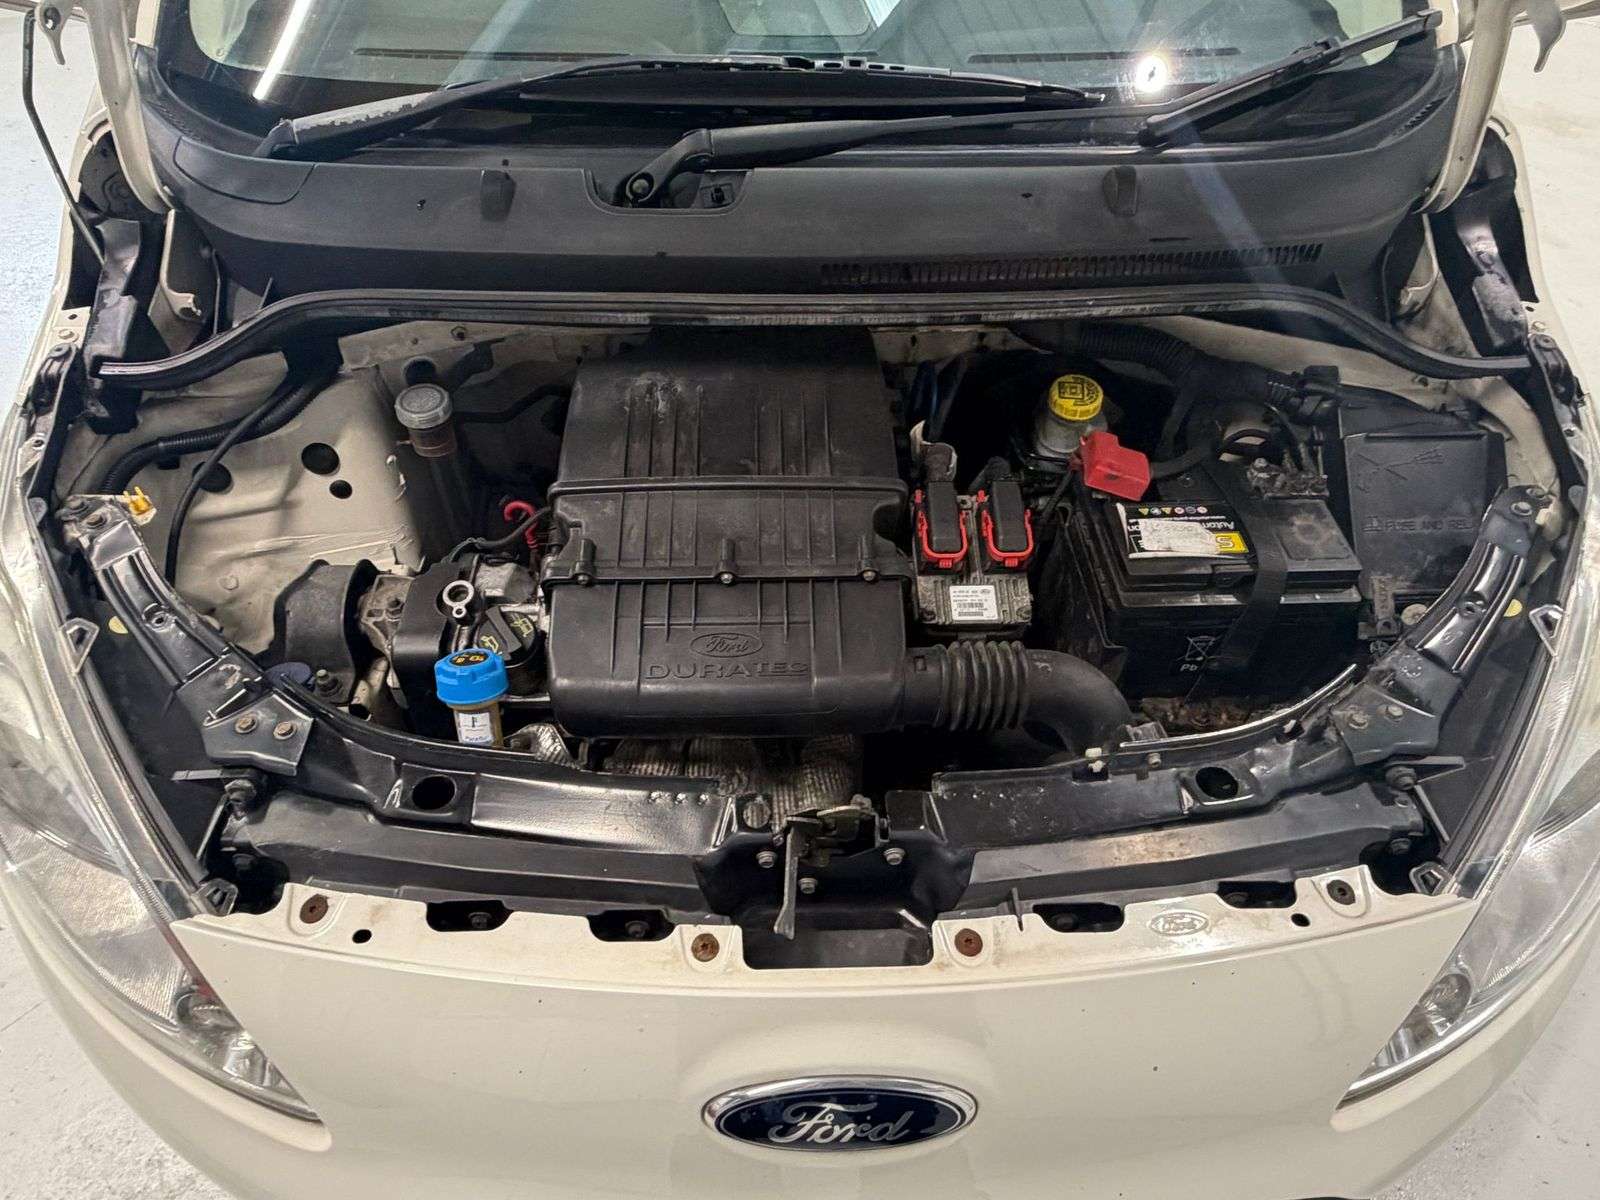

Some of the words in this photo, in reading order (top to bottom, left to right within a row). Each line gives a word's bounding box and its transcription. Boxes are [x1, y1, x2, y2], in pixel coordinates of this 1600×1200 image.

[1200, 520, 1235, 530] Autom
[1421, 519, 1444, 531] AND
[1448, 518, 1474, 530] REL
[705, 635, 750, 653] Ford
[1180, 663, 1199, 672] Pb
[768, 1101, 910, 1144] Ford
